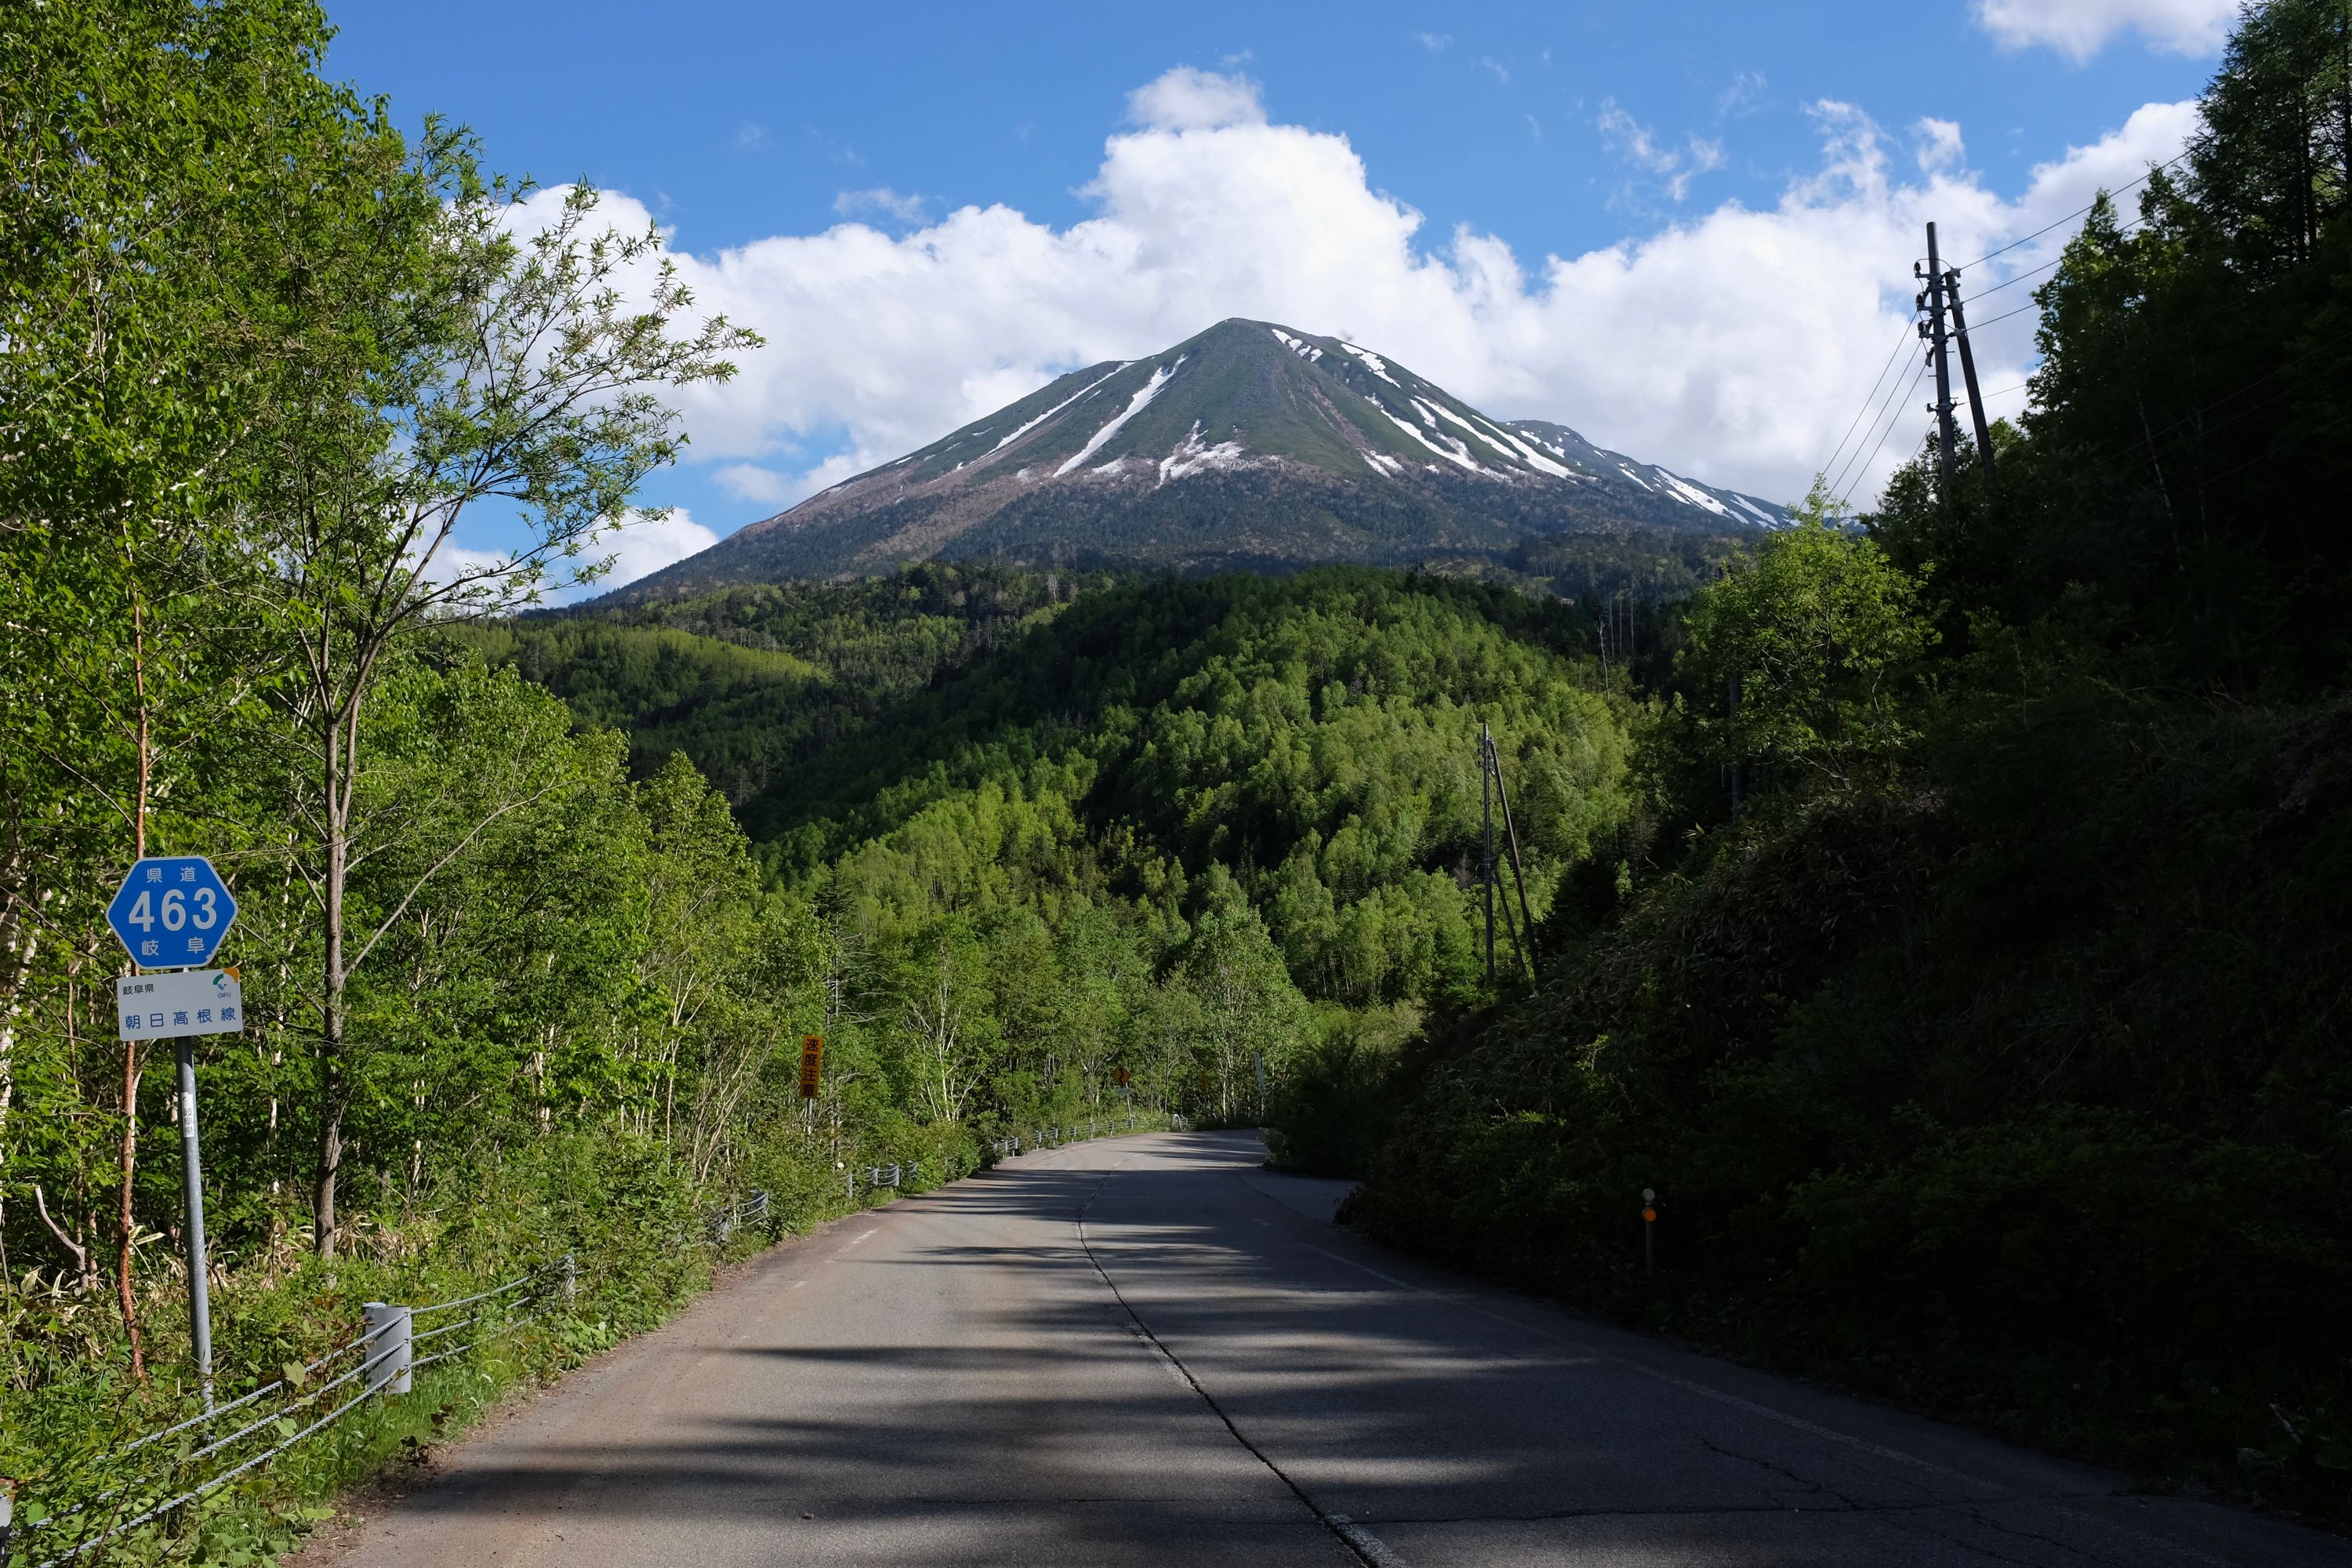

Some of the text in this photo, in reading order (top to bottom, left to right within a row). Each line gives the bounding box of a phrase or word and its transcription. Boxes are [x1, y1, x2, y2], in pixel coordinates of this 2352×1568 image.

[147, 866, 196, 884] 県道
[129, 887, 217, 932] 463
[141, 937, 205, 956] 岐阜
[122, 983, 155, 995] 岐阜県
[125, 1007, 237, 1030] 朝日高根線
[801, 1038, 819, 1096] 速度注意
